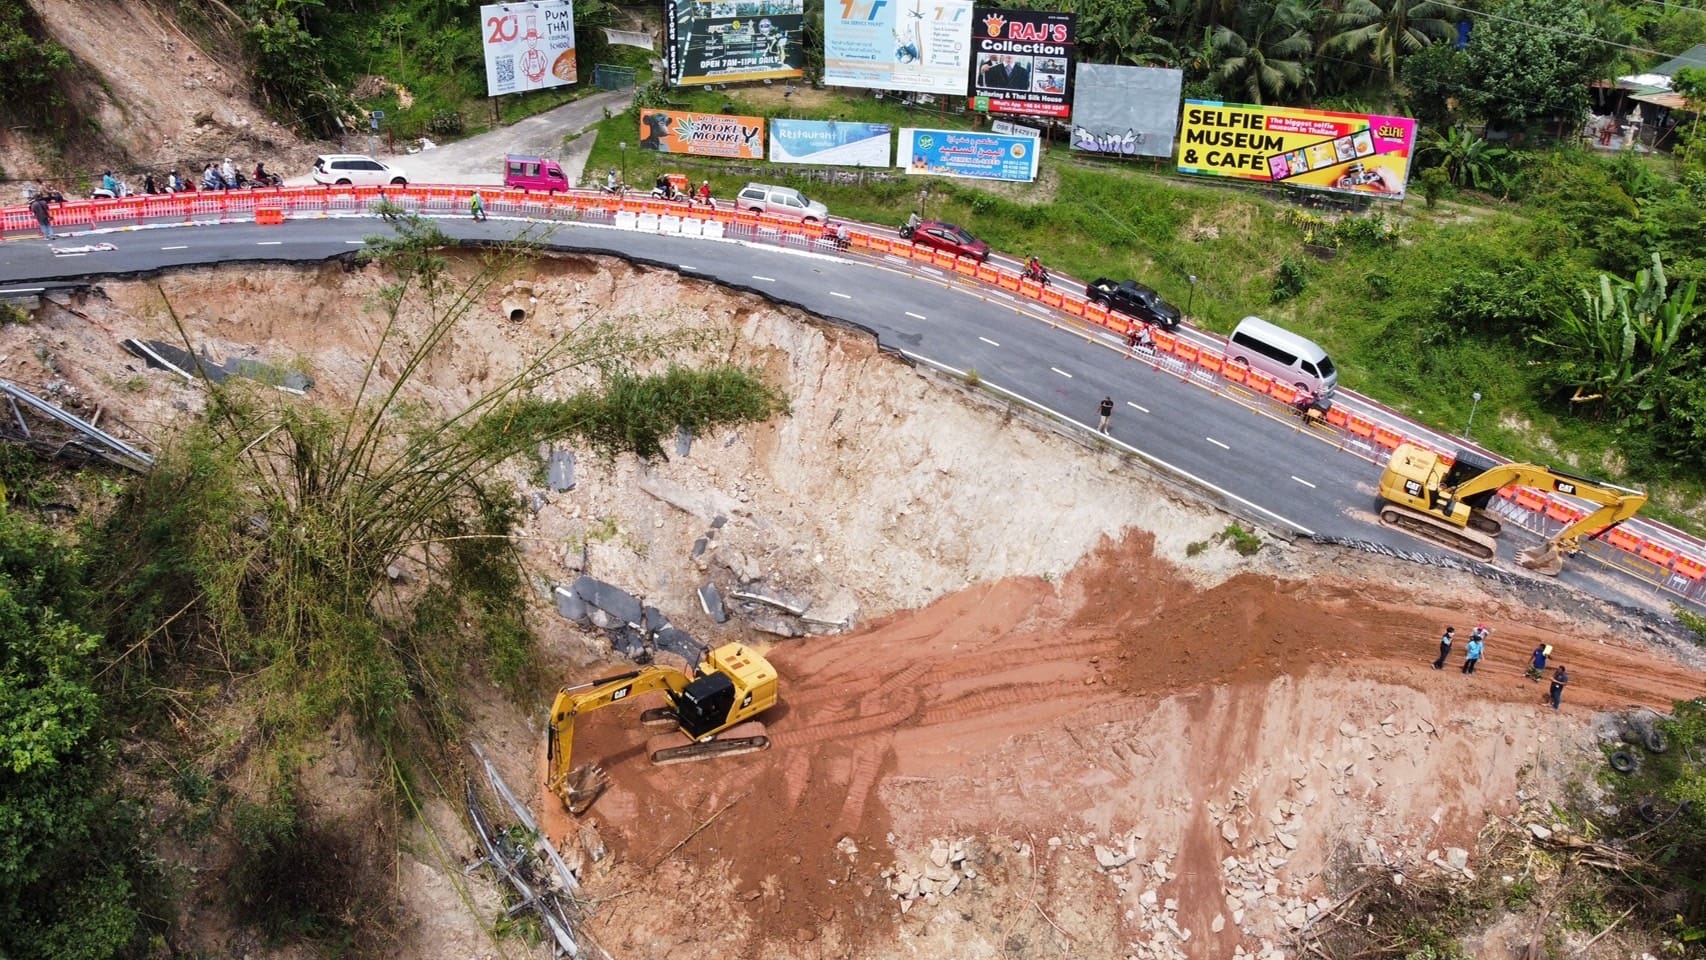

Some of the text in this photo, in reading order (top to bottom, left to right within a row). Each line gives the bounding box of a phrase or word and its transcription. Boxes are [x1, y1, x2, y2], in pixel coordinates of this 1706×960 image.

[545, 10, 568, 20] PUM
[668, 3, 676, 40] PATONG
[547, 20, 569, 35] THAI
[1008, 21, 1067, 42] RAJ'S
[981, 39, 1065, 55] Collection
[700, 59, 721, 69] OPEN
[758, 56, 779, 65] DAILY
[976, 90, 1004, 99] Tailoring
[1042, 95, 1063, 103] House
[1188, 109, 1264, 130] SELFIE
[1285, 119, 1312, 128] biggest
[780, 128, 837, 140] Restaurant
[1269, 124, 1299, 132] museum
[1308, 127, 1338, 136] Thailand
[1186, 128, 1284, 152] MUSEUM
[1184, 149, 1265, 171] & CAFÉ
[1405, 481, 1420, 491] CAT
[1558, 483, 1574, 493] CAT
[614, 688, 627, 699] CAT
